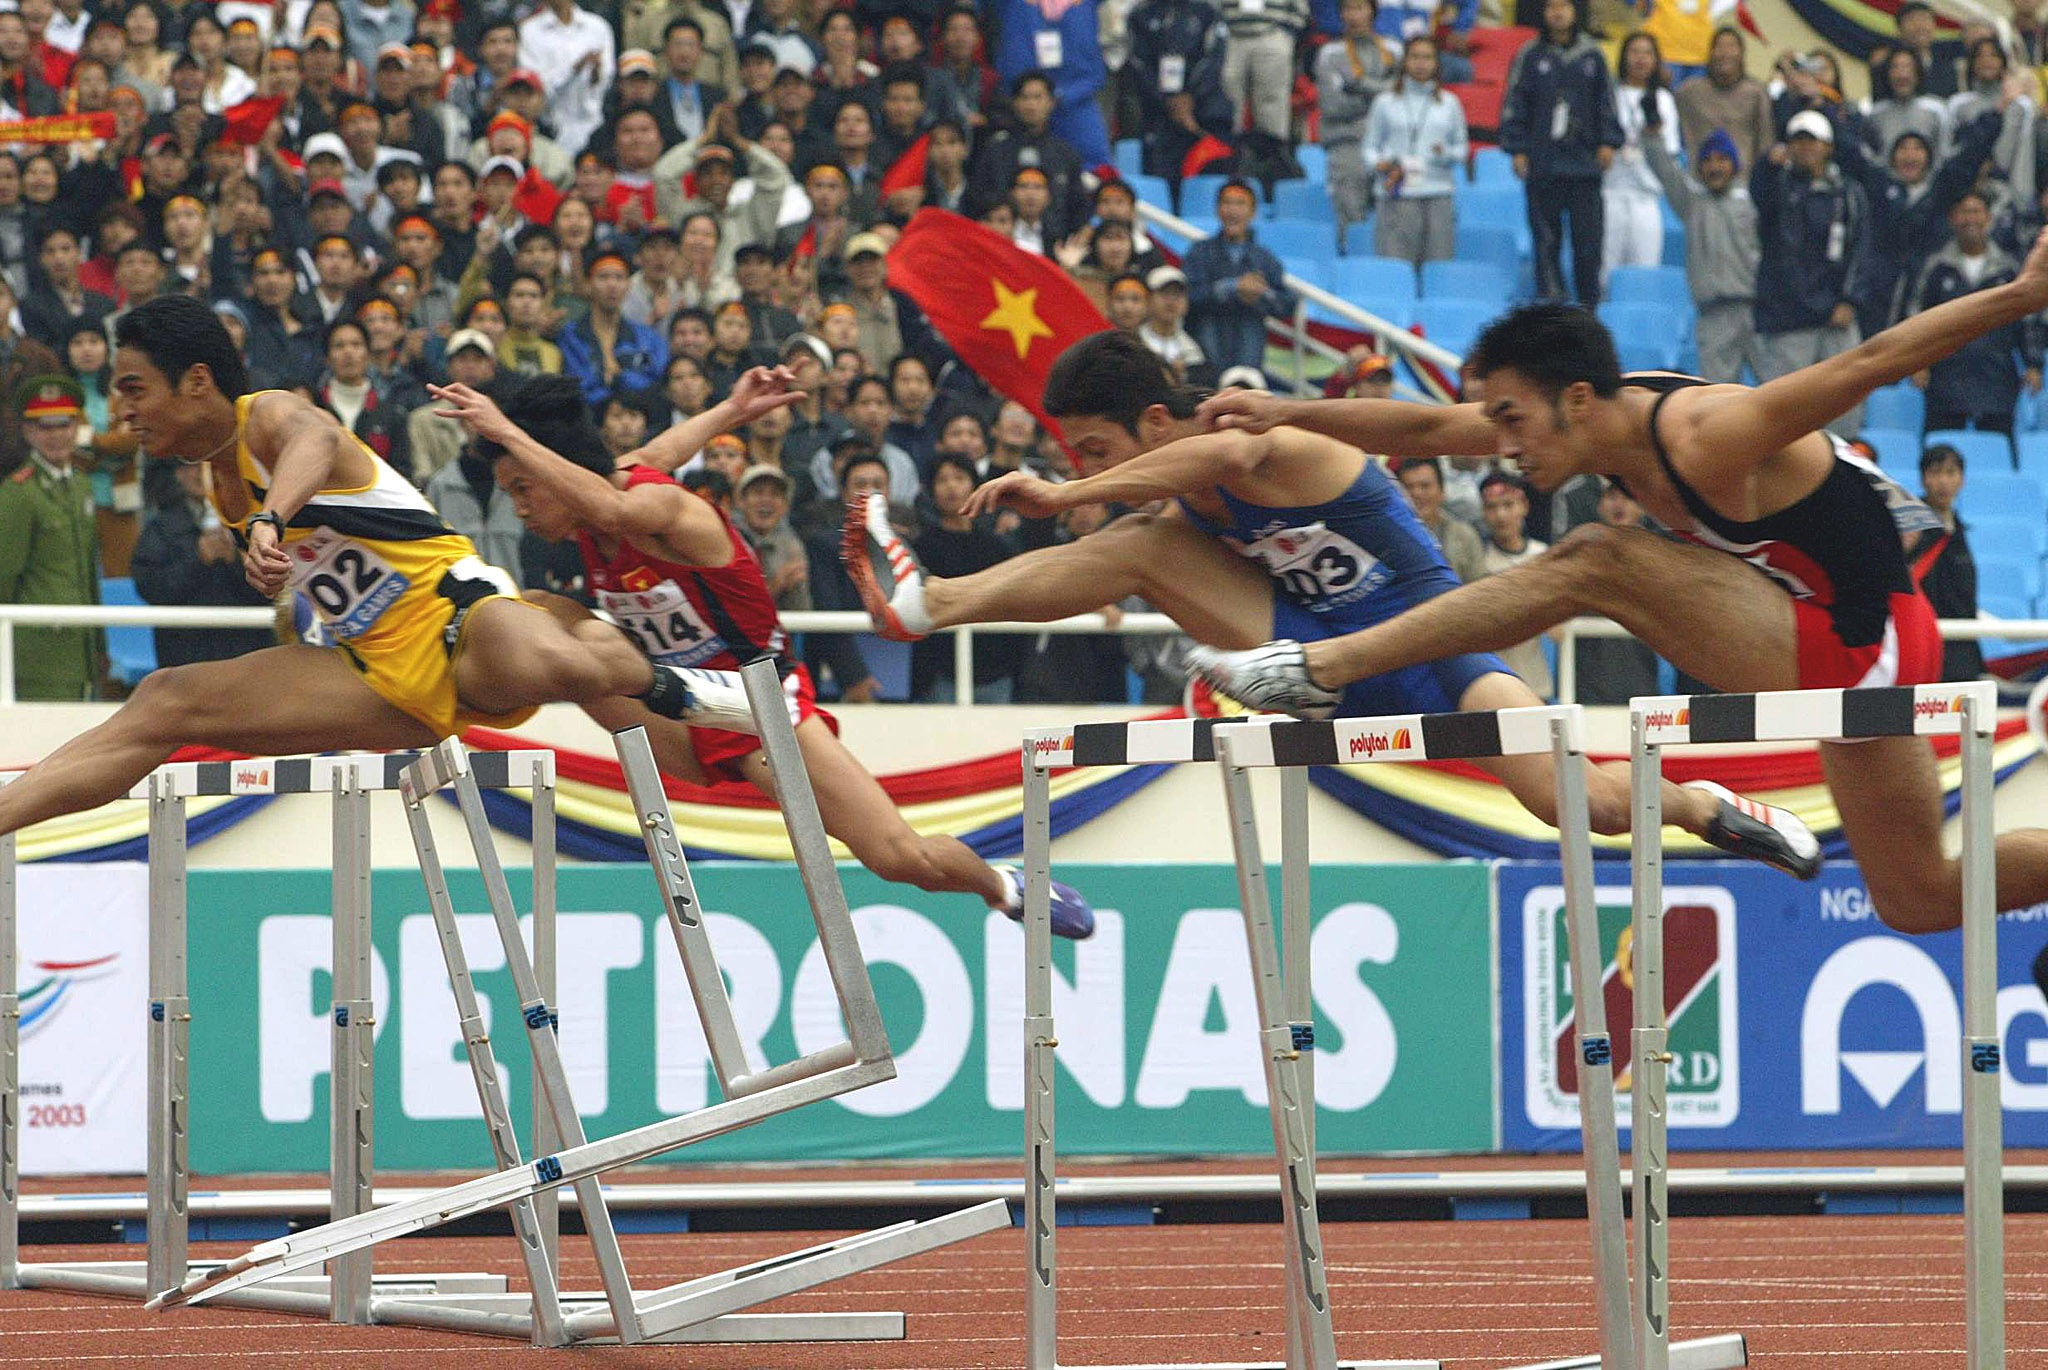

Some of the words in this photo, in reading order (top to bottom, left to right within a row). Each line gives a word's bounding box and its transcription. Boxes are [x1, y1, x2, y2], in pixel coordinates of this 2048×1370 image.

[308, 549, 382, 615] 02
[1645, 712, 1674, 731] polytan
[1915, 699, 1949, 720] polytan
[1035, 737, 1061, 754] polytan
[1349, 734, 1390, 758] polytan
[257, 902, 1399, 1123] PETRONAS
[28, 1104, 86, 1128] 2003
